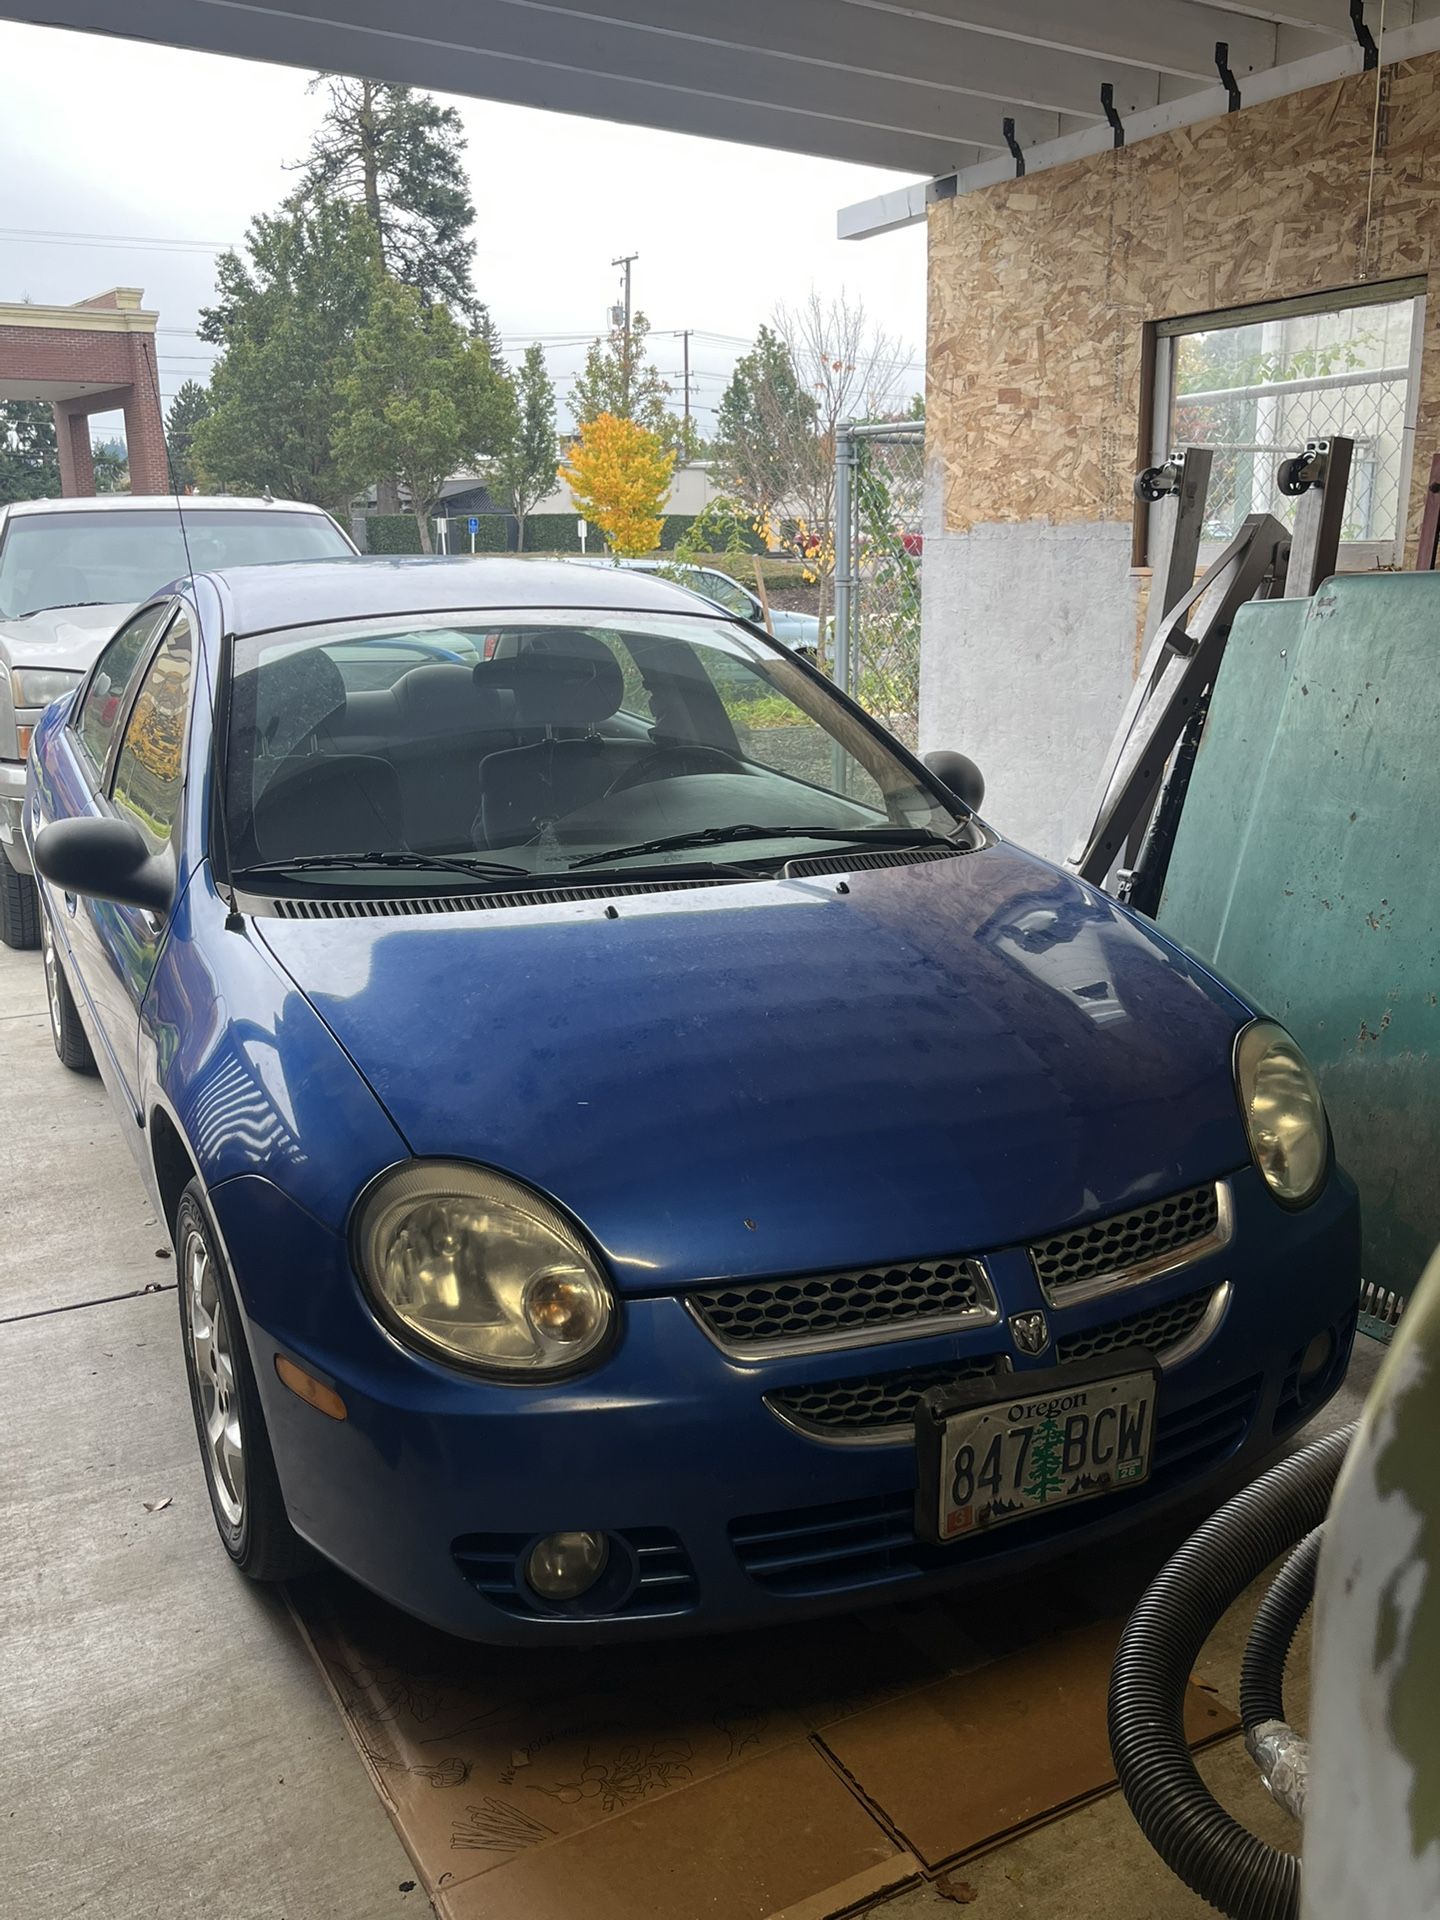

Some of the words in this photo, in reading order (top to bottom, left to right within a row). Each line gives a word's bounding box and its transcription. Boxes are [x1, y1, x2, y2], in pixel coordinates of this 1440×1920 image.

[1007, 1392, 1088, 1421] Oregon
[952, 1426, 1034, 1506] 847
[1062, 1400, 1146, 1474] BCW
[1120, 1467, 1136, 1476] 26
[954, 1513, 965, 1527] 3
